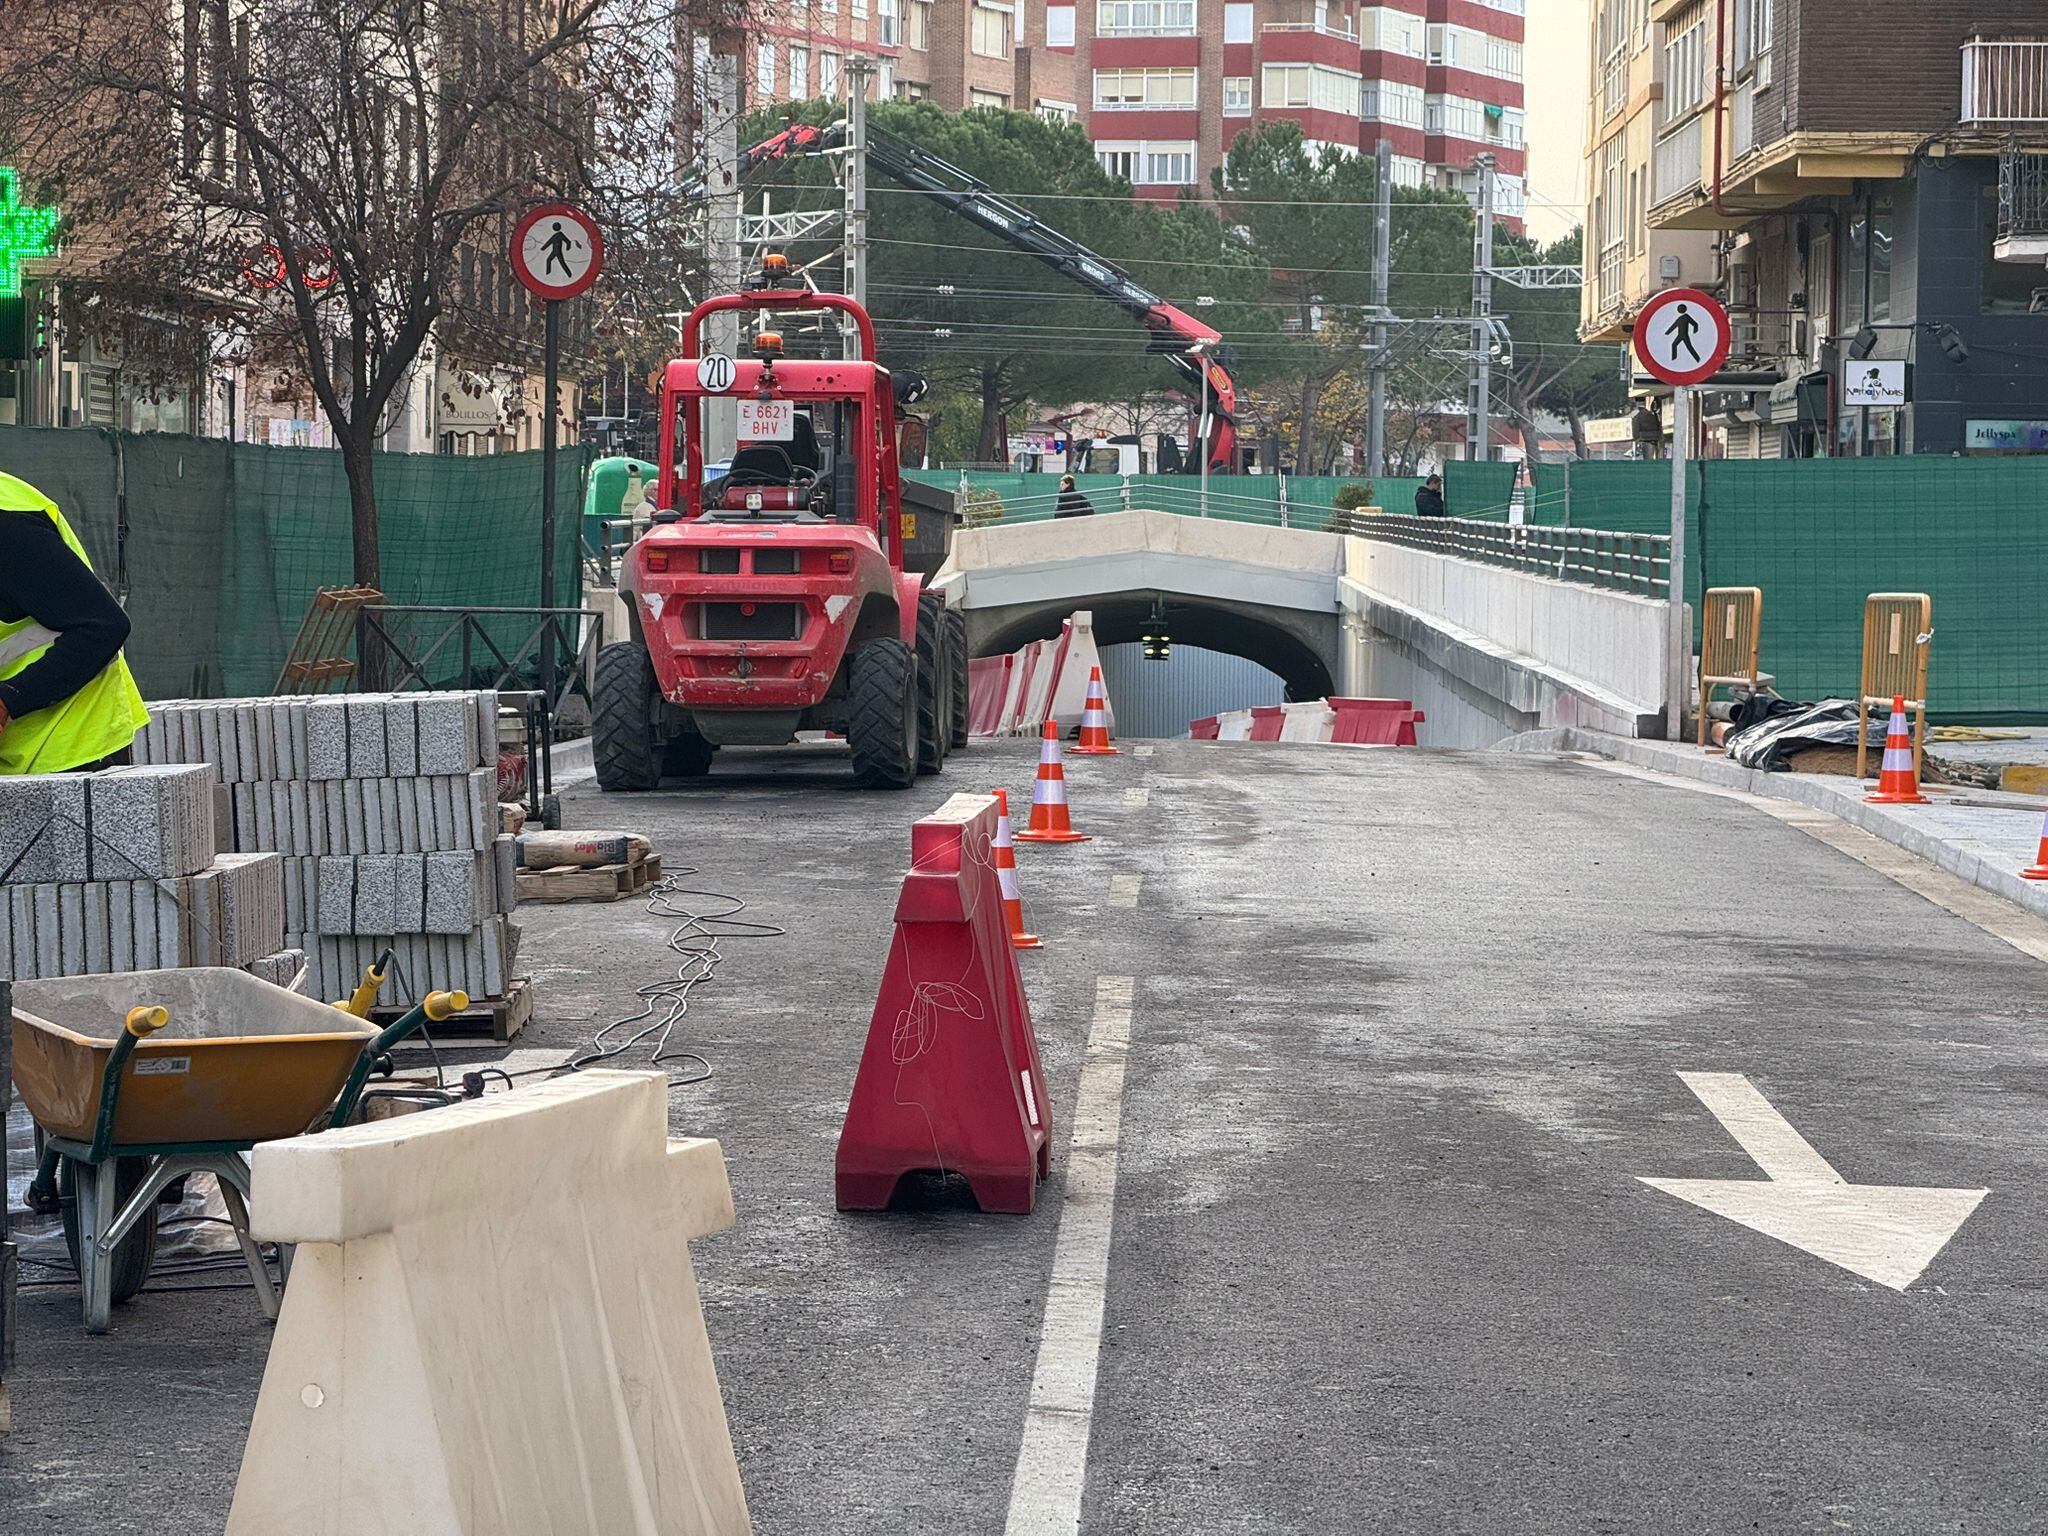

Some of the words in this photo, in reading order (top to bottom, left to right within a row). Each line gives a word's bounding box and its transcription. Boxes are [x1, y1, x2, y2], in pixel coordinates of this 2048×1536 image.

[978, 205, 1009, 229] HERGON
[706, 357, 728, 388] 20
[446, 410, 489, 419] BOLILLOS
[743, 405, 751, 418] E
[757, 405, 788, 419] 6621
[752, 421, 778, 435] BHV
[1975, 428, 2016, 440] Jellyspa
